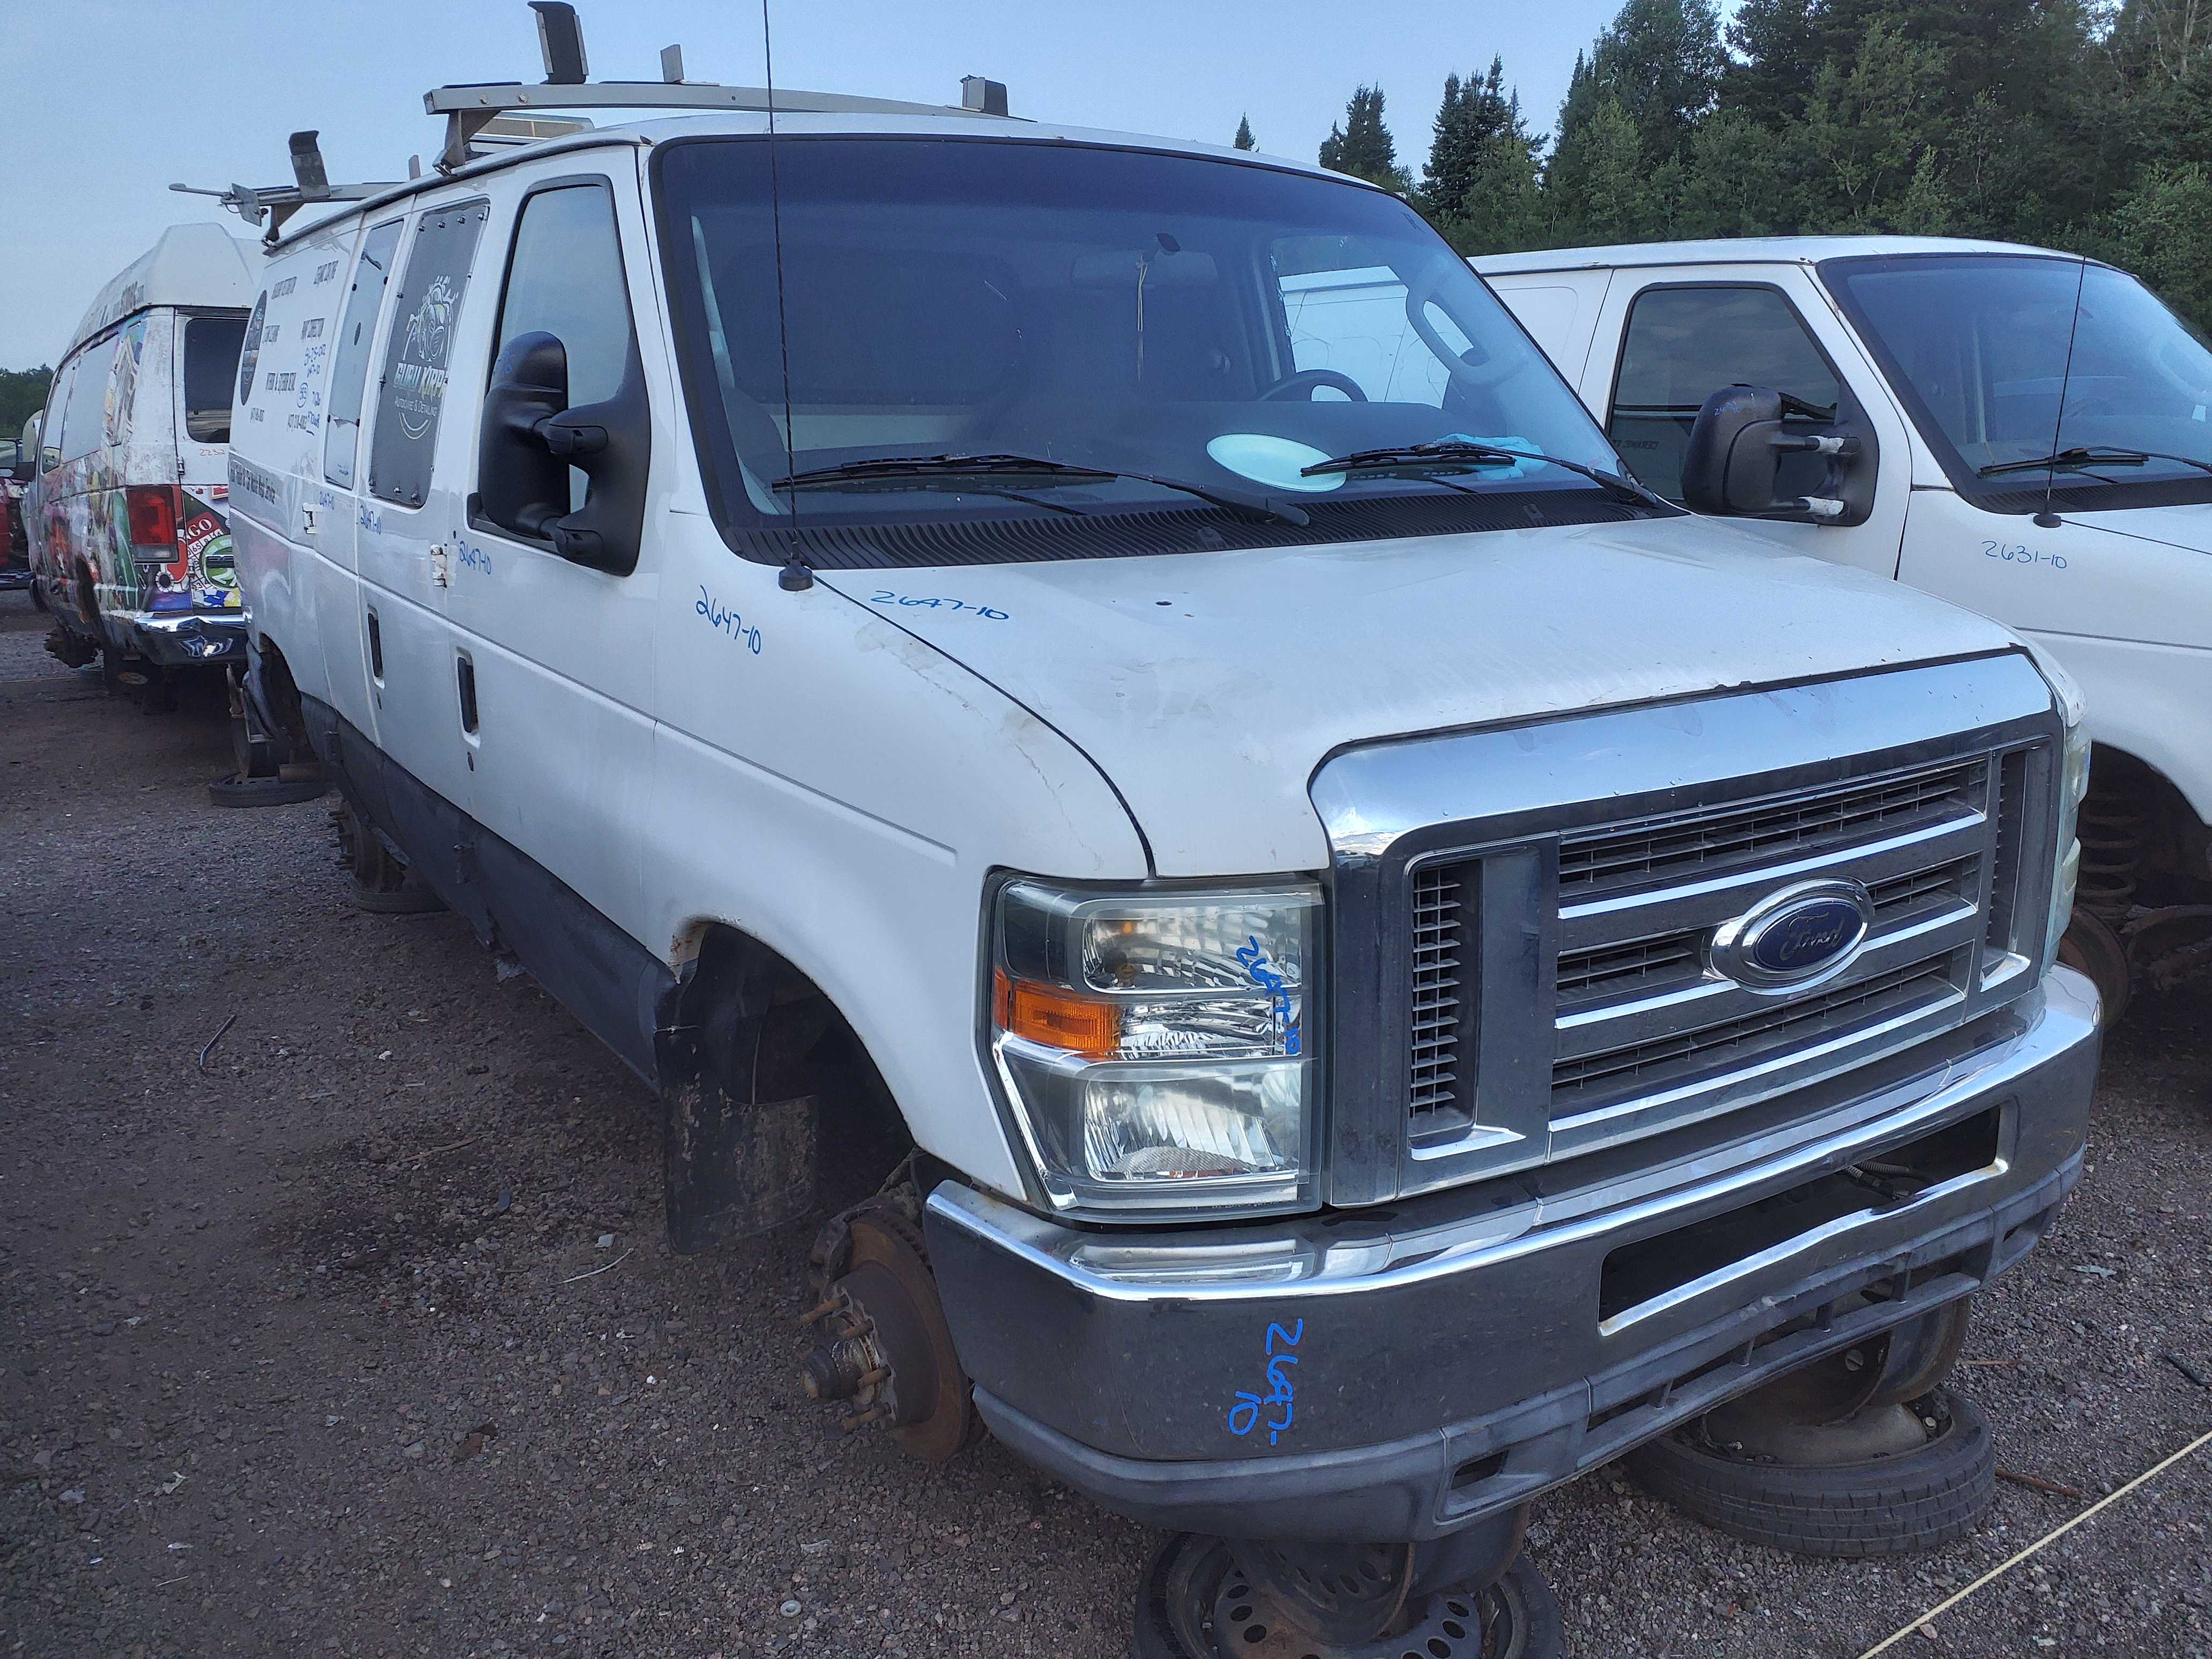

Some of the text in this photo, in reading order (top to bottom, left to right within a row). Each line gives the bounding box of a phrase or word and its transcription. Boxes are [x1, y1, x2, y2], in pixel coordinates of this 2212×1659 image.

[1982, 540, 2067, 569] 2631-10
[696, 585, 761, 655] 2647-10
[870, 590, 1010, 621] 2647-10
[1779, 910, 1845, 961] Ford
